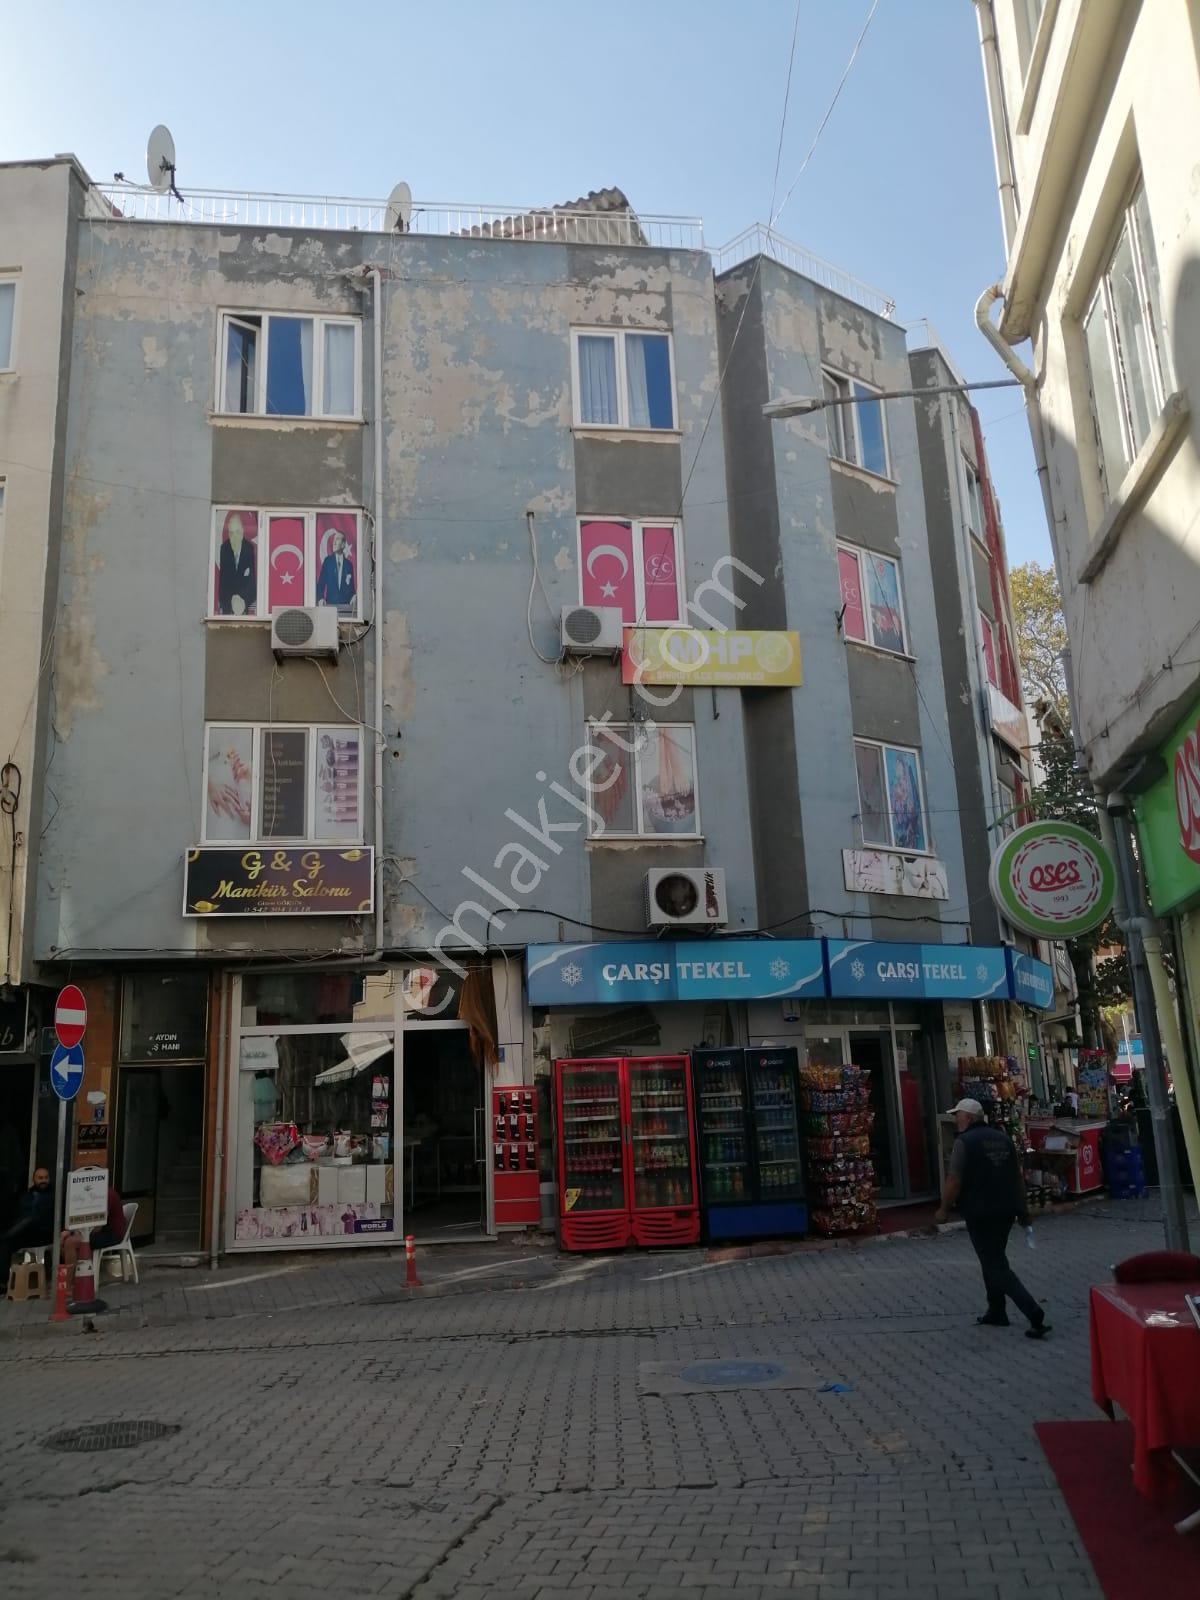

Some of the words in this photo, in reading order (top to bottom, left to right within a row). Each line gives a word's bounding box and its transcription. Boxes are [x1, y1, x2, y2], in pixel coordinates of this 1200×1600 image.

[668, 634, 754, 665] MHP
[241, 851, 265, 880] G
[270, 850, 292, 872] &
[300, 851, 326, 879] G
[1028, 859, 1081, 890] oses
[211, 879, 290, 899] Manikür
[291, 878, 352, 898] Salonu
[602, 963, 670, 985] ÇARŞI
[676, 961, 751, 980] TEKEL
[877, 961, 920, 984] ÇARŞI
[922, 962, 967, 981] TEKEL
[155, 1033, 177, 1041] AYDIN
